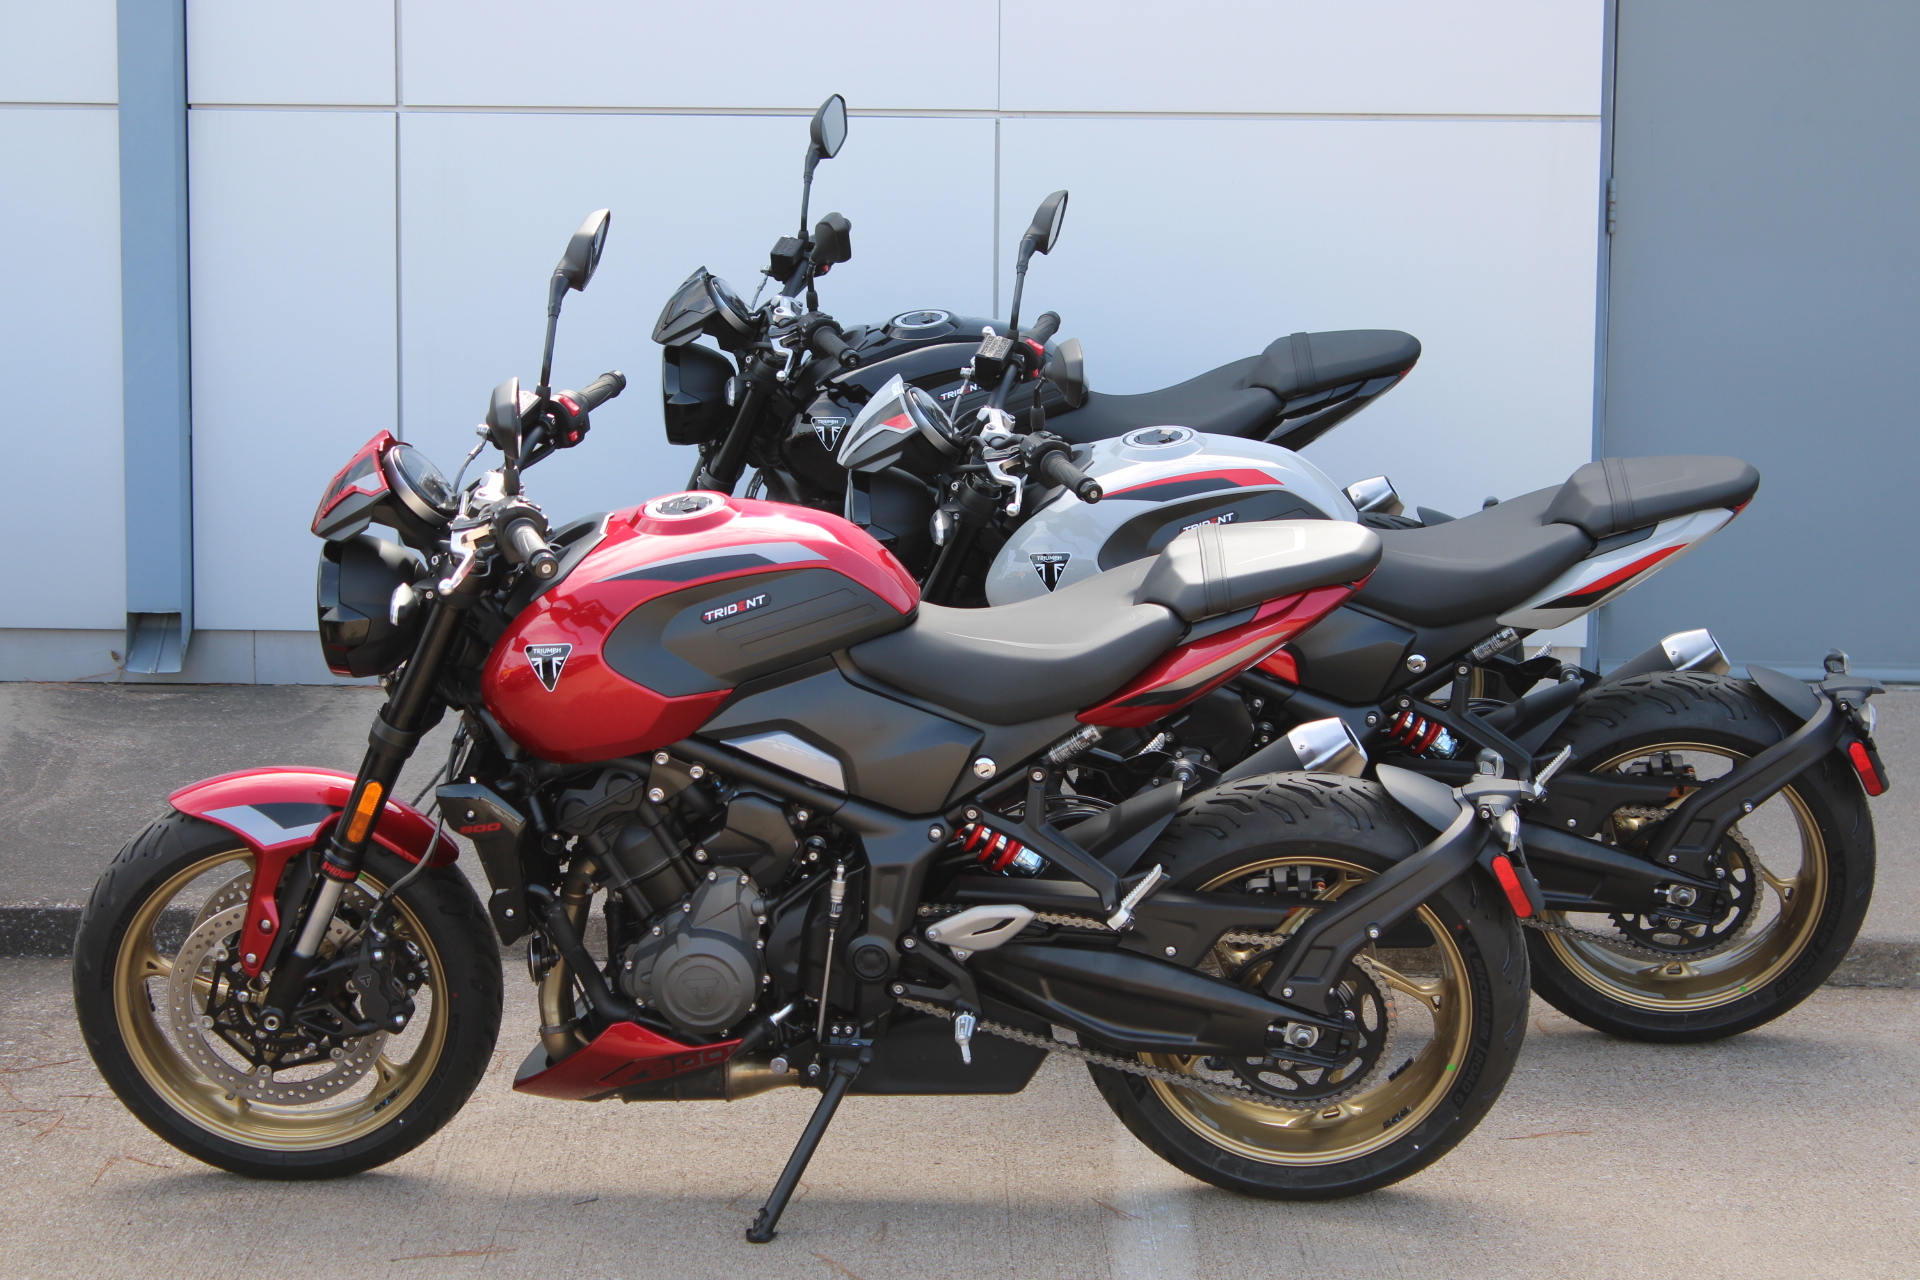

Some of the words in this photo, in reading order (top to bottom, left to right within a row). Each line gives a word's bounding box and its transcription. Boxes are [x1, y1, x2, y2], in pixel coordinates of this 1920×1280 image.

[941, 384, 981, 400] TRIEN
[704, 594, 766, 621] TRIDENT
[533, 647, 562, 656] TRIUMPH
[322, 861, 357, 879] SHOWA
[1473, 956, 1492, 1041] MICHELIN
[1462, 1054, 1485, 1092] ROAD
